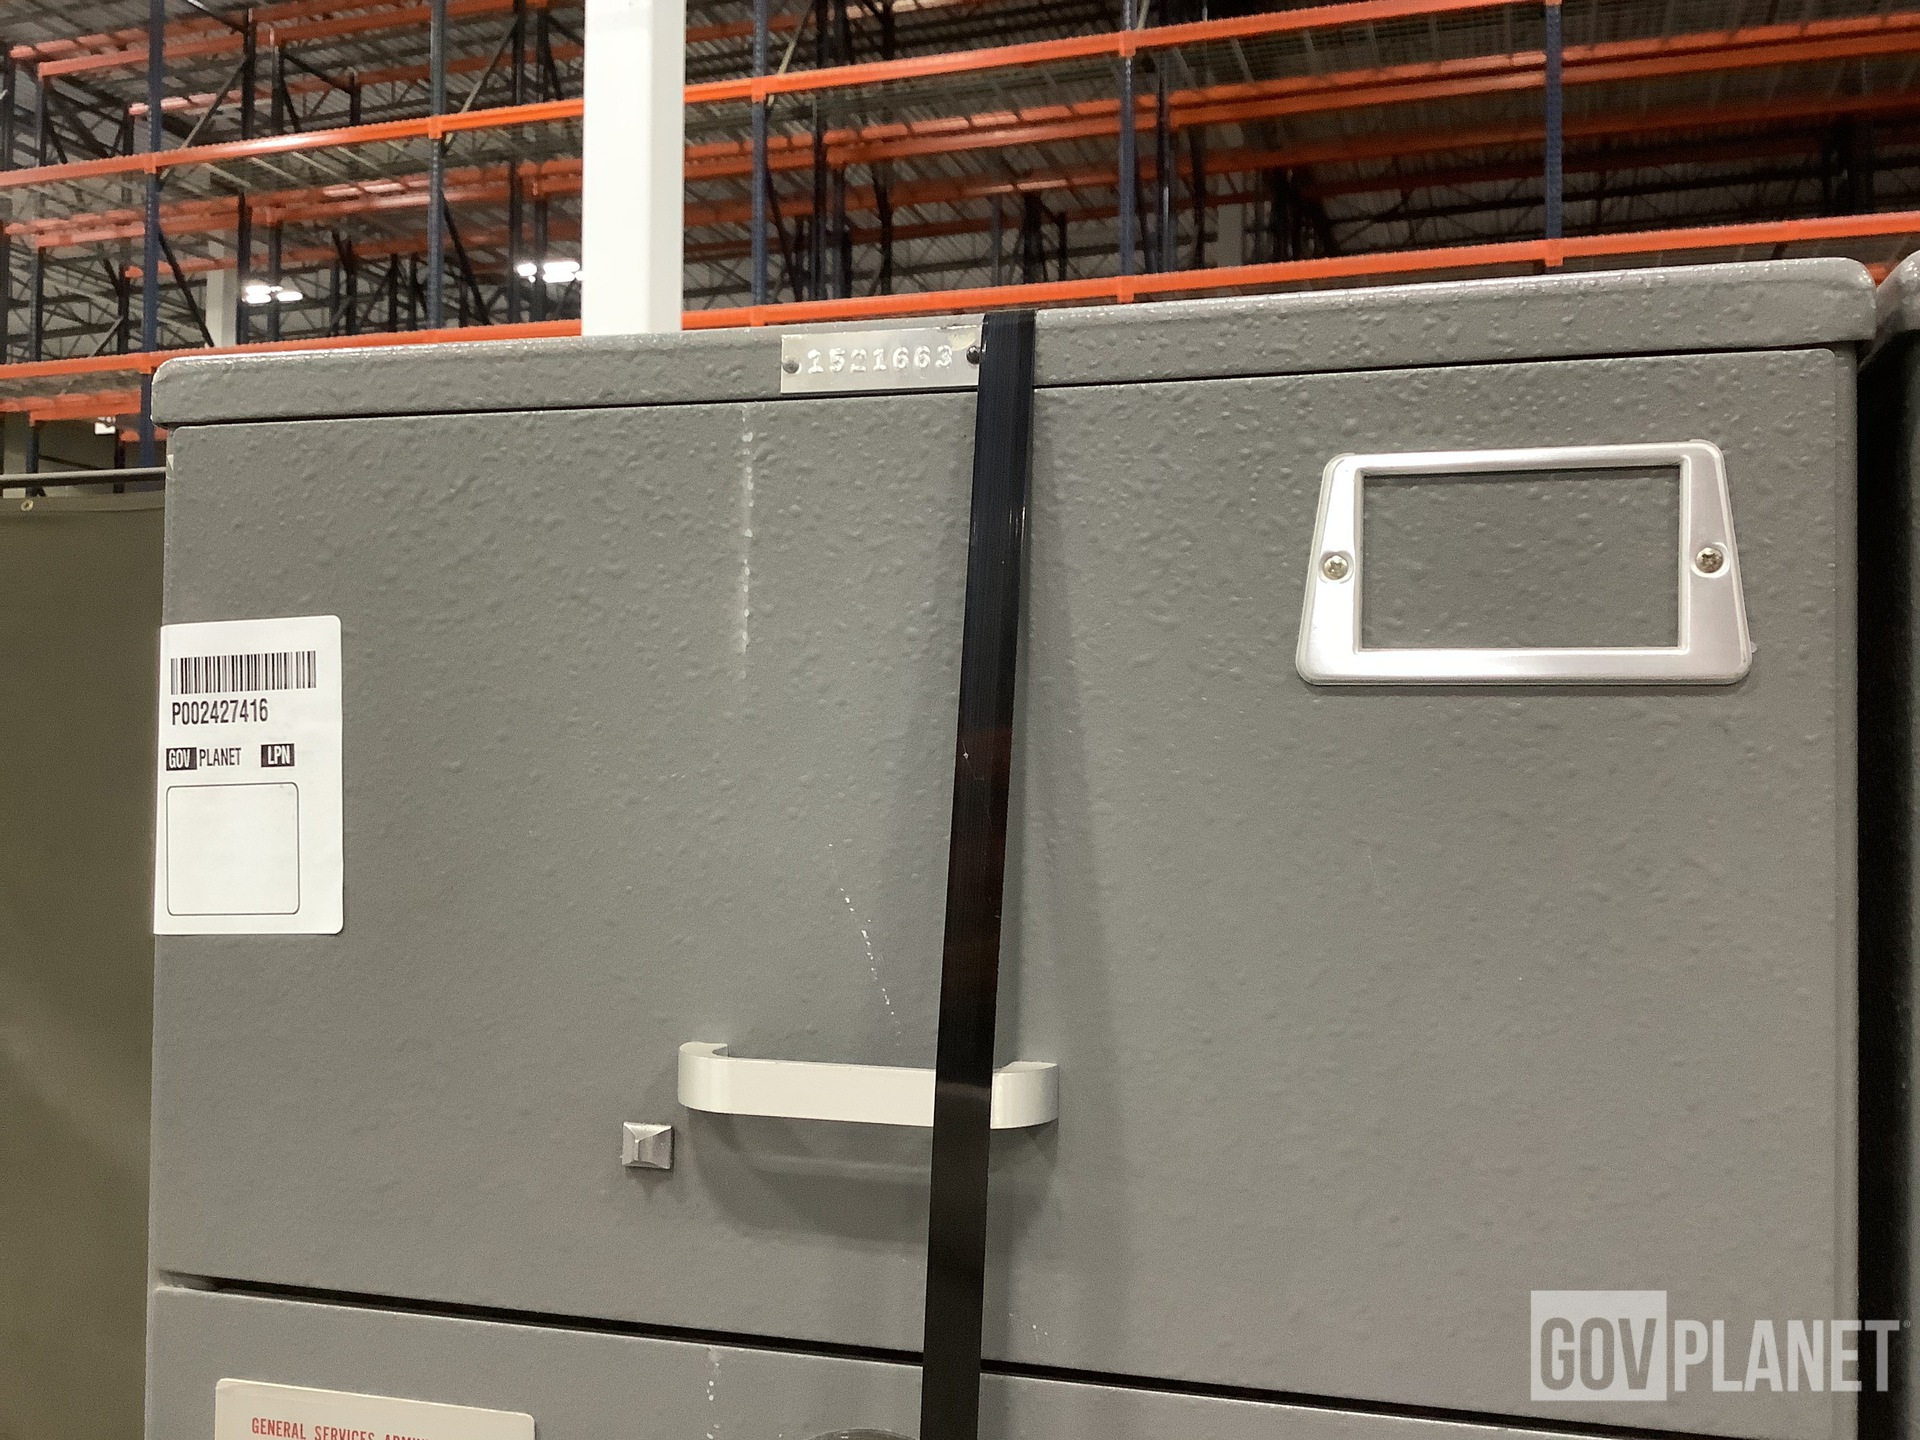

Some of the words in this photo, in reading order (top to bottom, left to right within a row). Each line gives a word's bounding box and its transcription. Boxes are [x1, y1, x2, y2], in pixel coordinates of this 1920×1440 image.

[807, 345, 953, 374] 1521663
[172, 698, 269, 725] P002427416
[267, 745, 291, 765] LPN
[252, 1417, 306, 1440] GENERAL
